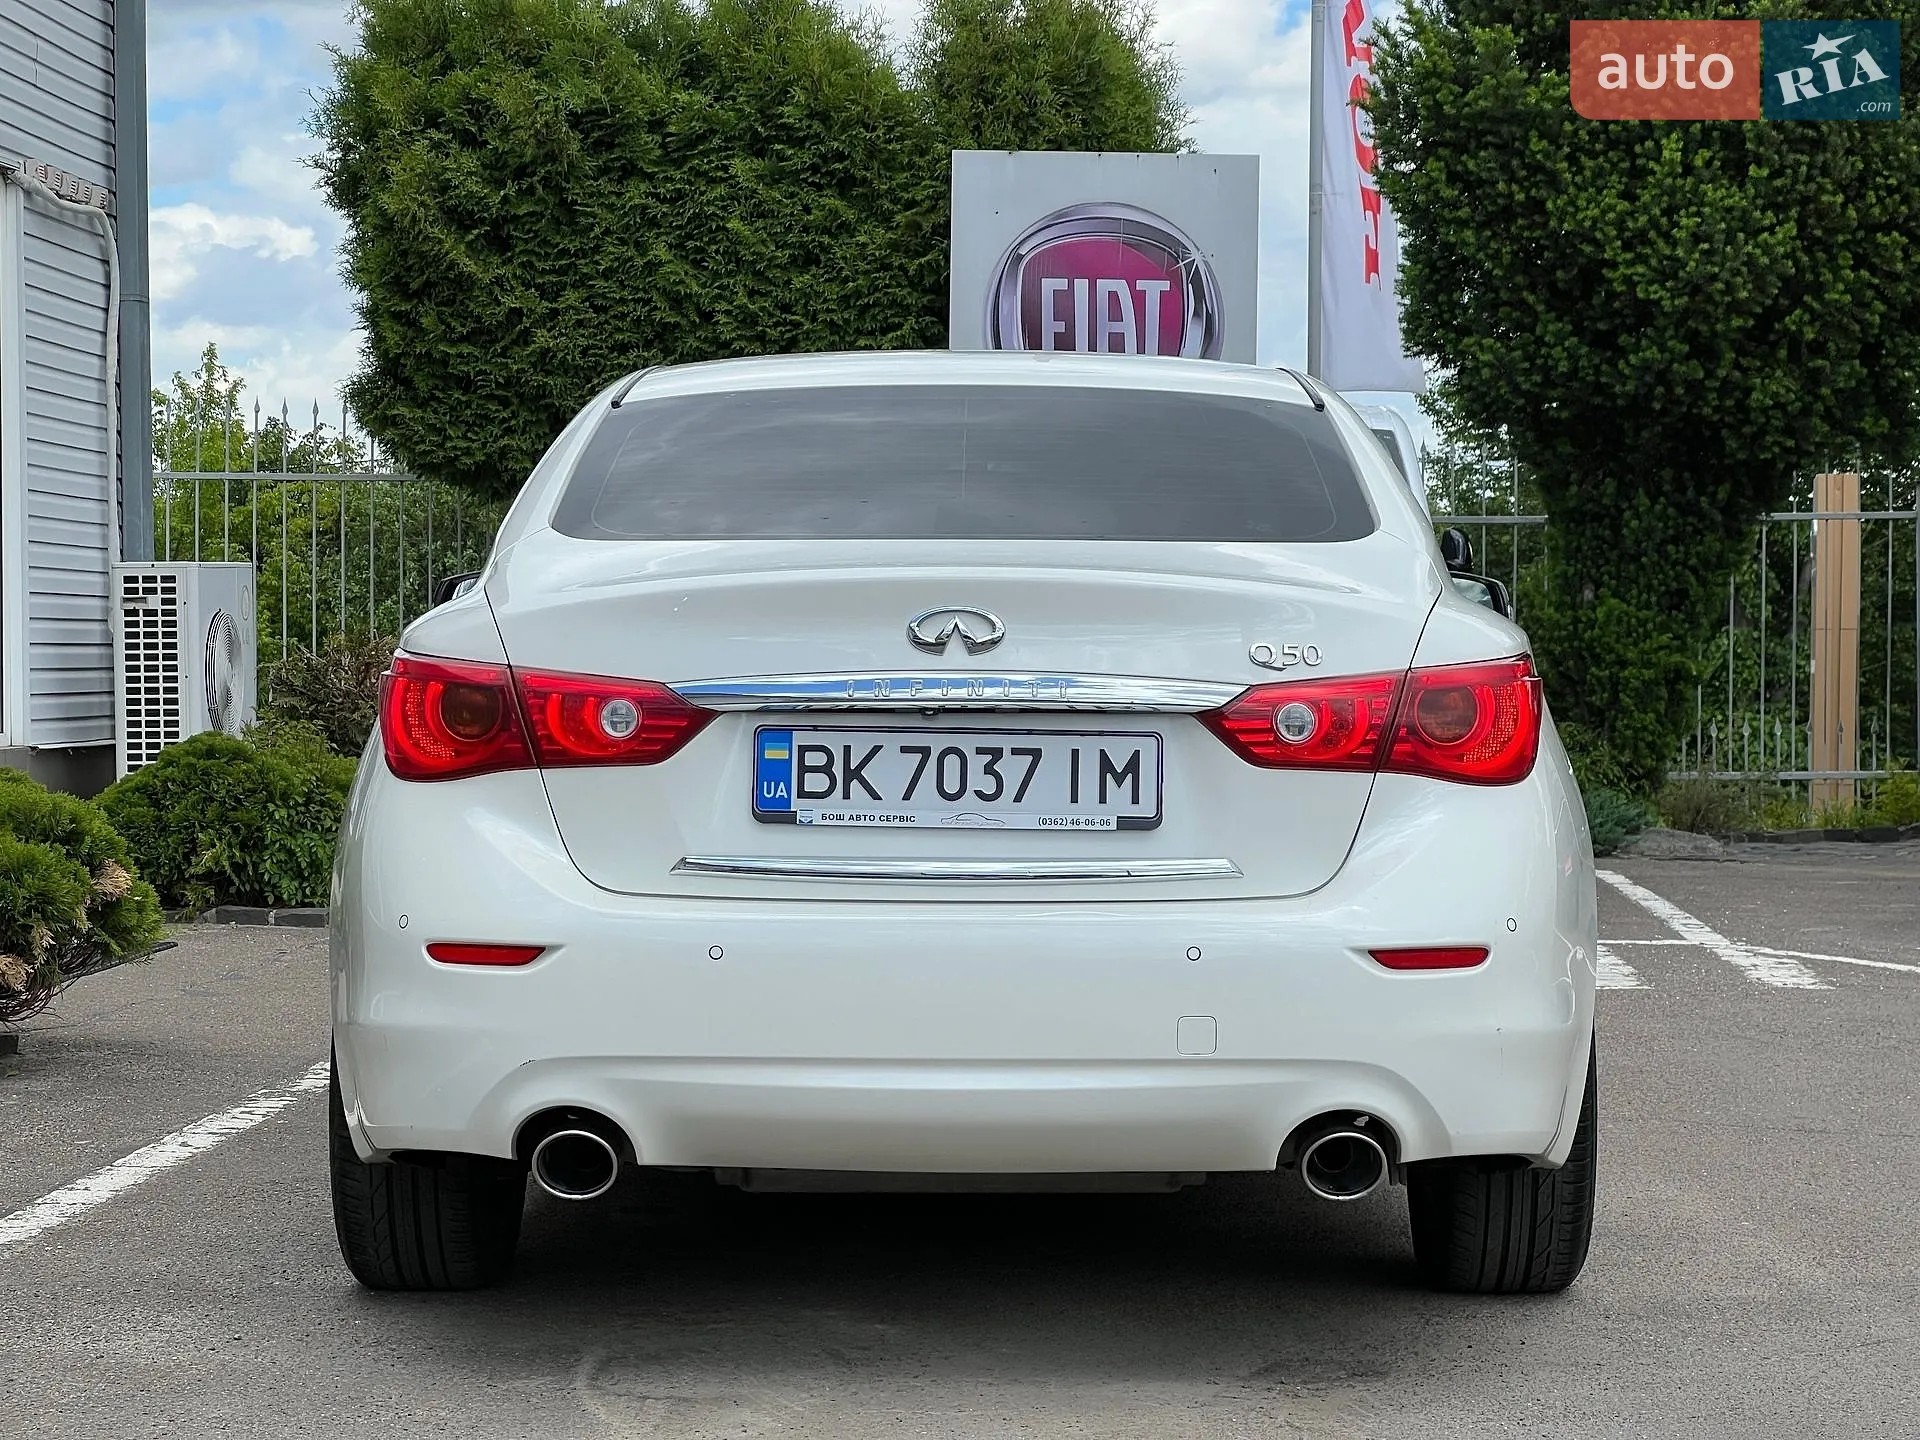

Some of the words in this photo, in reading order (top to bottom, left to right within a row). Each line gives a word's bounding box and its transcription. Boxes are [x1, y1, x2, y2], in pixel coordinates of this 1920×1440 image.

[1041, 277, 1171, 355] FIAT
[1249, 643, 1323, 672] Q50
[846, 679, 1067, 699] INFINITI
[797, 744, 884, 801] BK
[900, 745, 1043, 803] 7037
[1070, 748, 1141, 805] IM
[763, 781, 788, 799] UA
[821, 813, 845, 821] БОШ
[848, 813, 876, 823] АВТО
[878, 814, 916, 823] СЕРВІС
